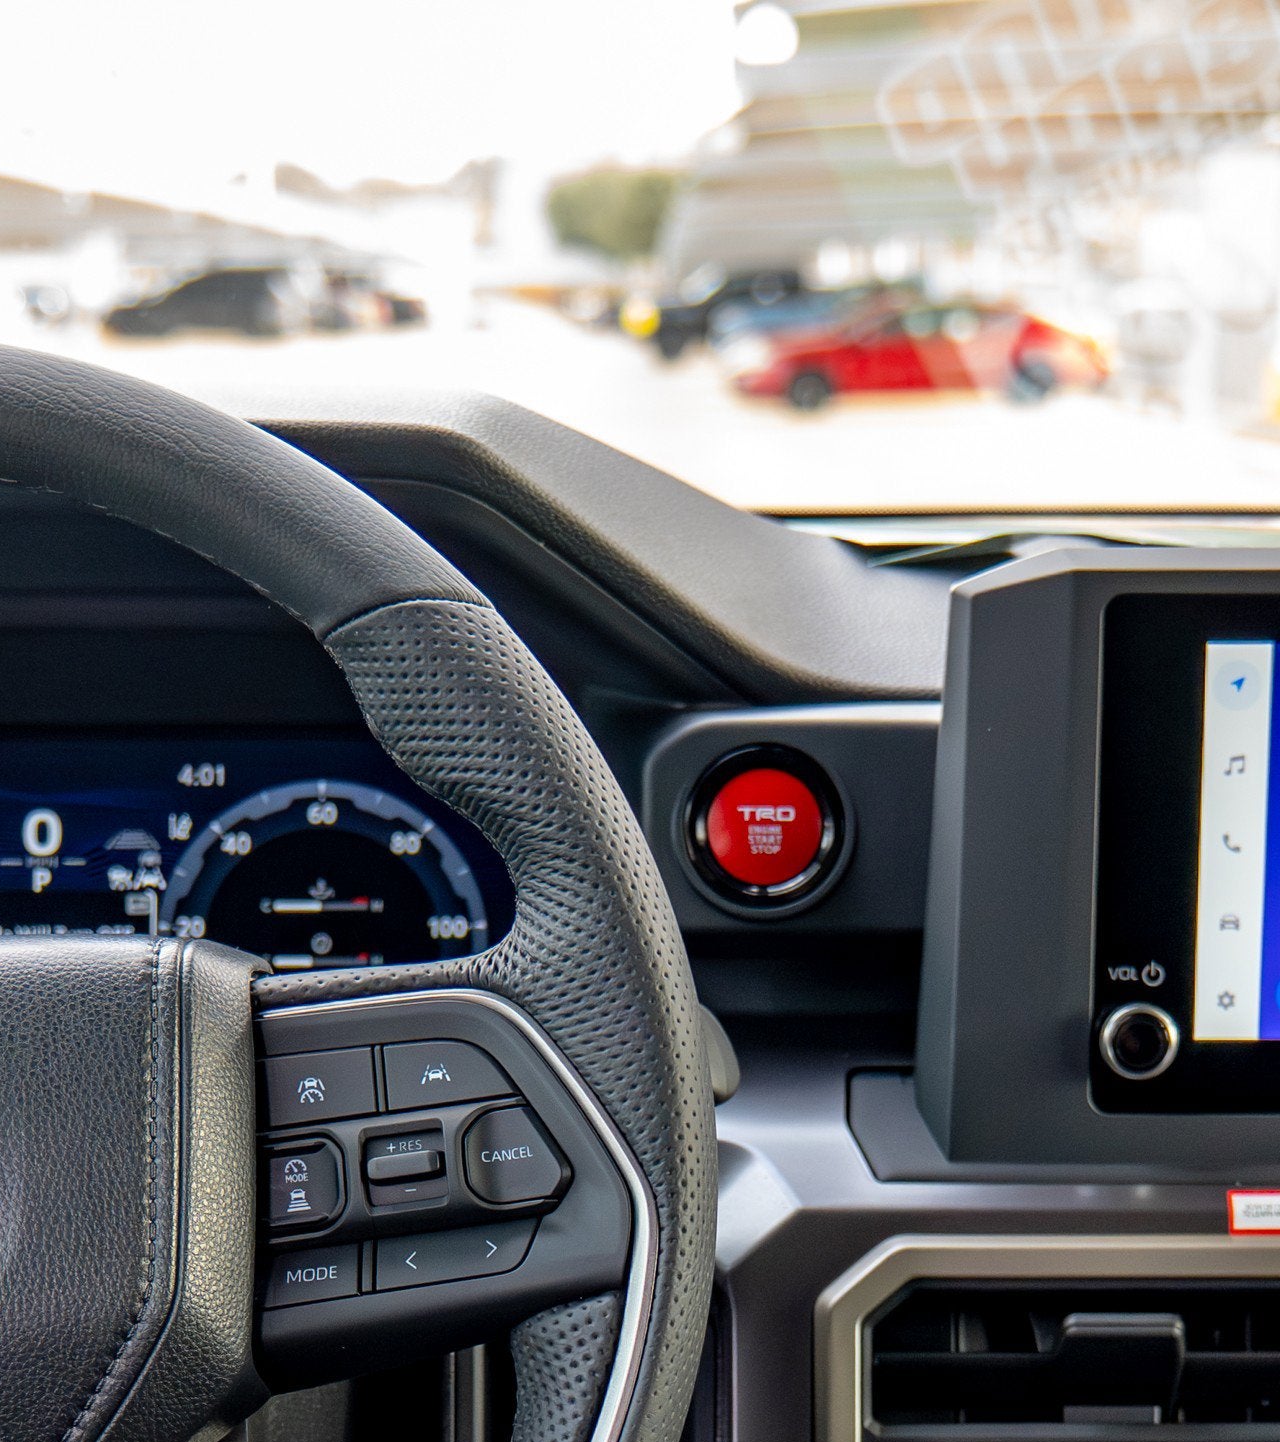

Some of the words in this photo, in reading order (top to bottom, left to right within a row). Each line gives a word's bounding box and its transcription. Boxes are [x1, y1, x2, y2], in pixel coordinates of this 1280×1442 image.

[177, 762, 226, 788] 4:01
[305, 801, 339, 825] 60
[736, 805, 797, 822] TRD
[21, 807, 64, 858] 0
[221, 831, 253, 856] 40
[388, 830, 422, 855] 80
[31, 867, 53, 894] P
[174, 915, 207, 939] 20
[426, 914, 470, 940] 100
[1107, 966, 1140, 981] VOL
[480, 1145, 535, 1164] CANCEL
[285, 1172, 309, 1184] MODE
[285, 1264, 339, 1285] MODE
